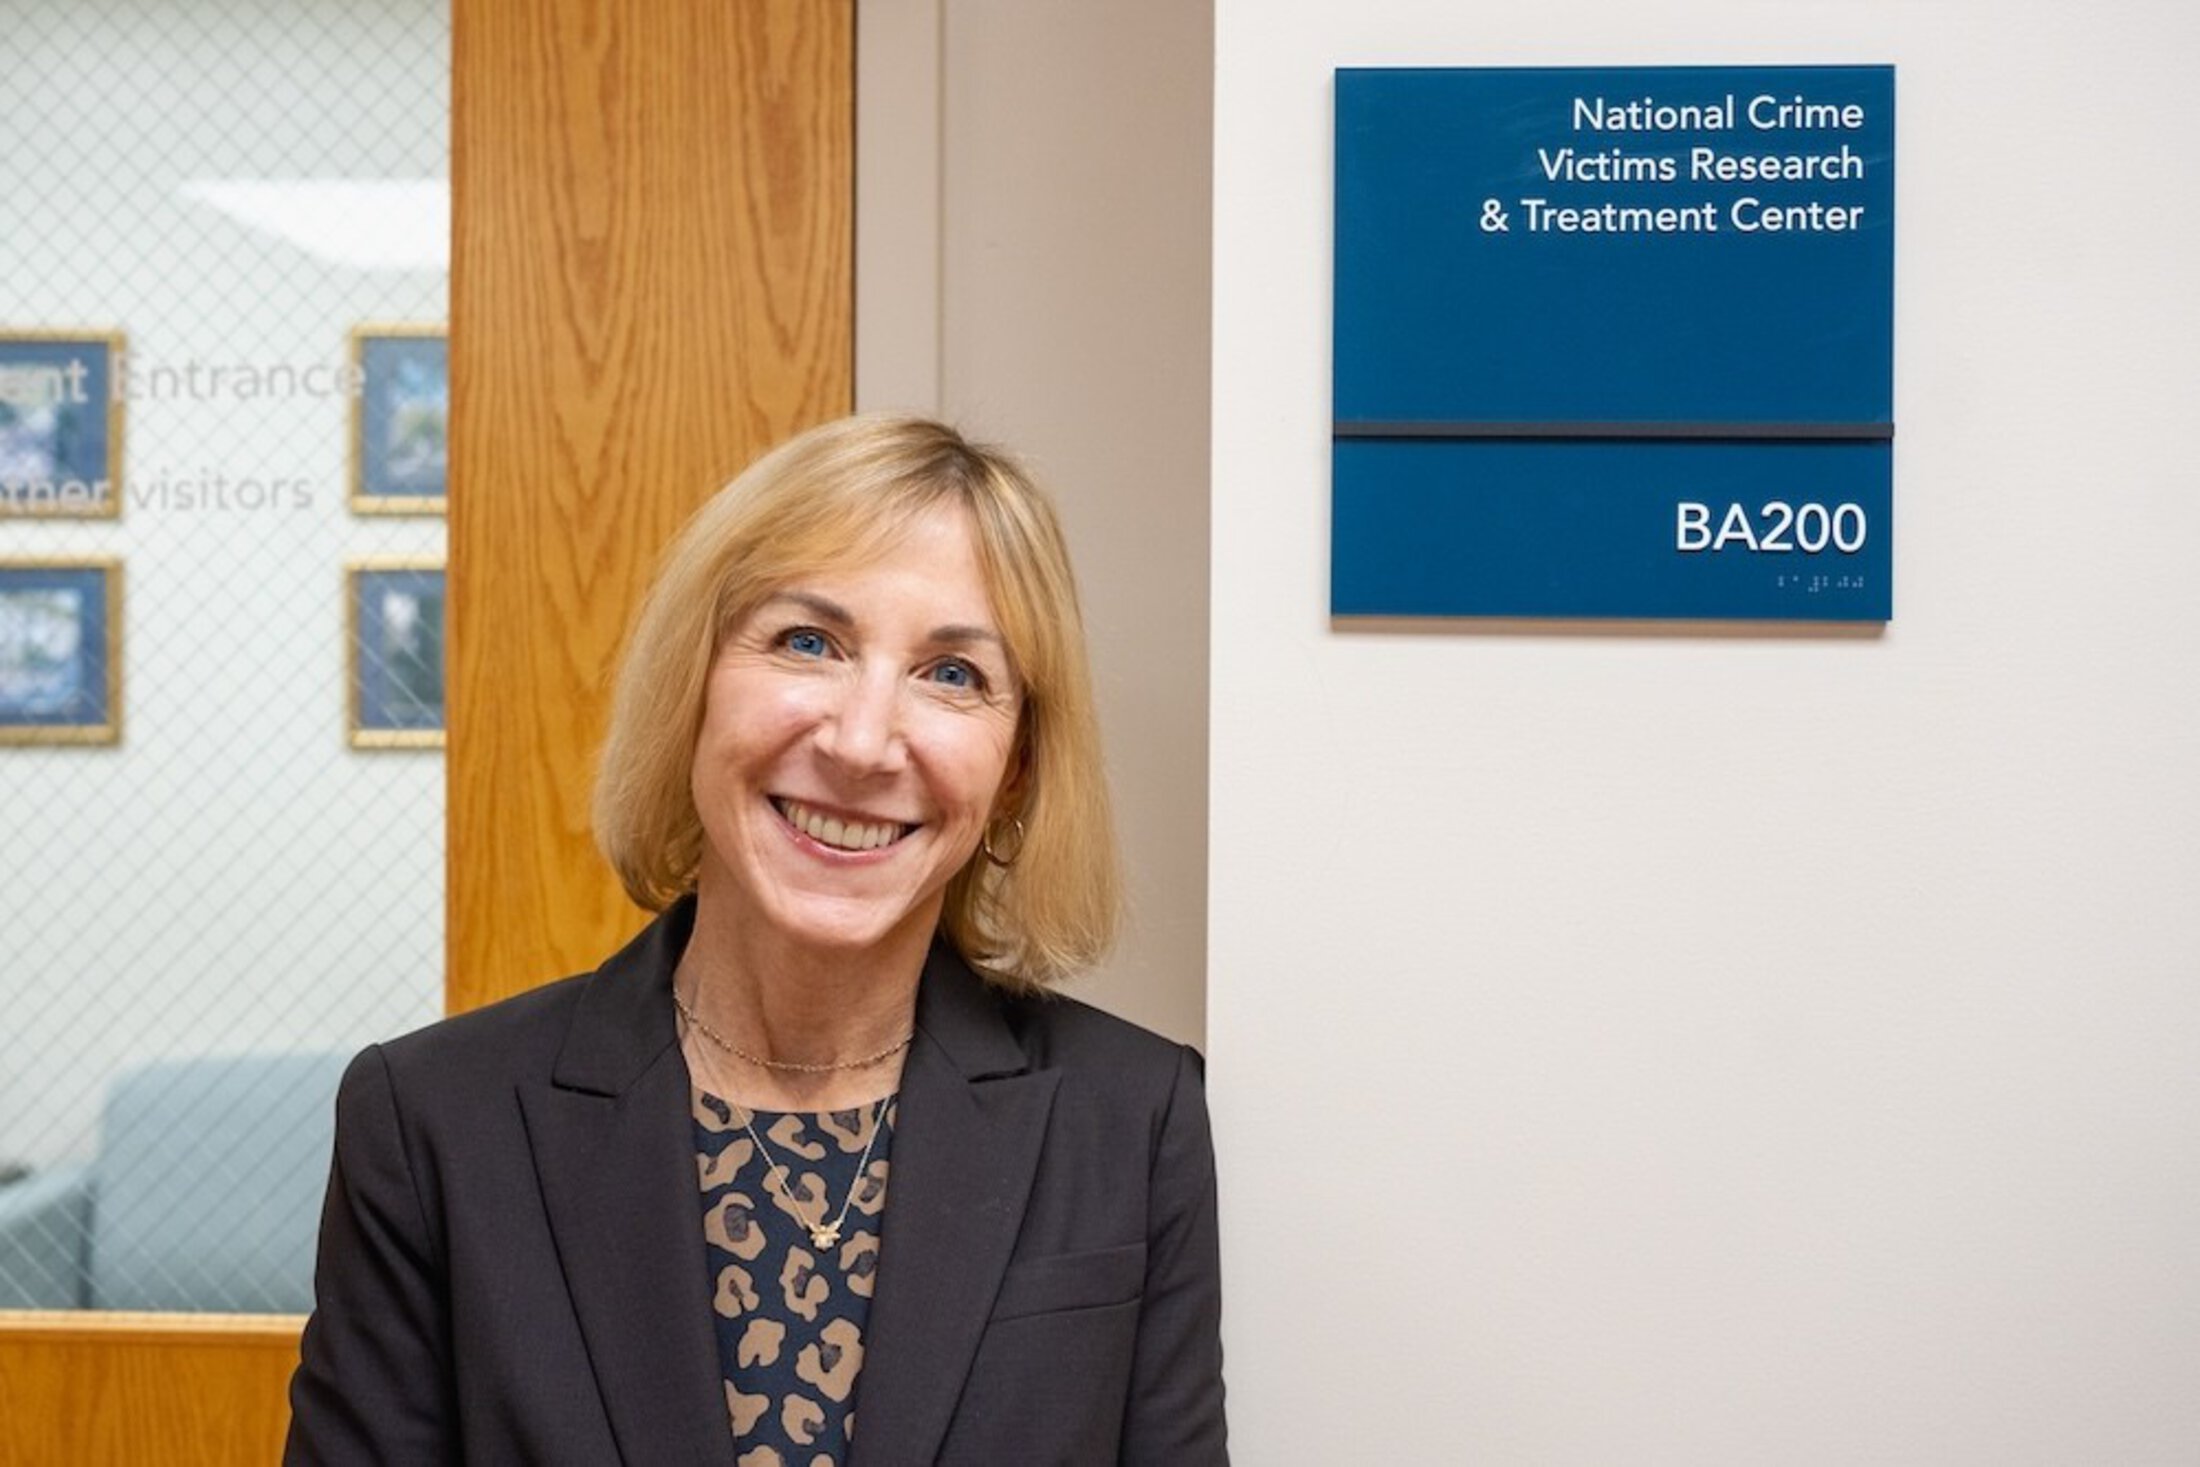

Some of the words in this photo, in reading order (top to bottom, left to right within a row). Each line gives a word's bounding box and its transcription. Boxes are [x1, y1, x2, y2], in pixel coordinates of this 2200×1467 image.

[1573, 94, 1734, 131] National
[1748, 95, 1864, 130] Crime
[1538, 148, 1677, 182] Victims
[1691, 144, 1863, 181] Research
[1480, 198, 1509, 232] &
[1520, 199, 1718, 232] Treatment
[1731, 197, 1864, 231] Center
[112, 352, 367, 402] Entrance
[130, 466, 314, 511] visitors
[1676, 501, 1867, 553] BA200
